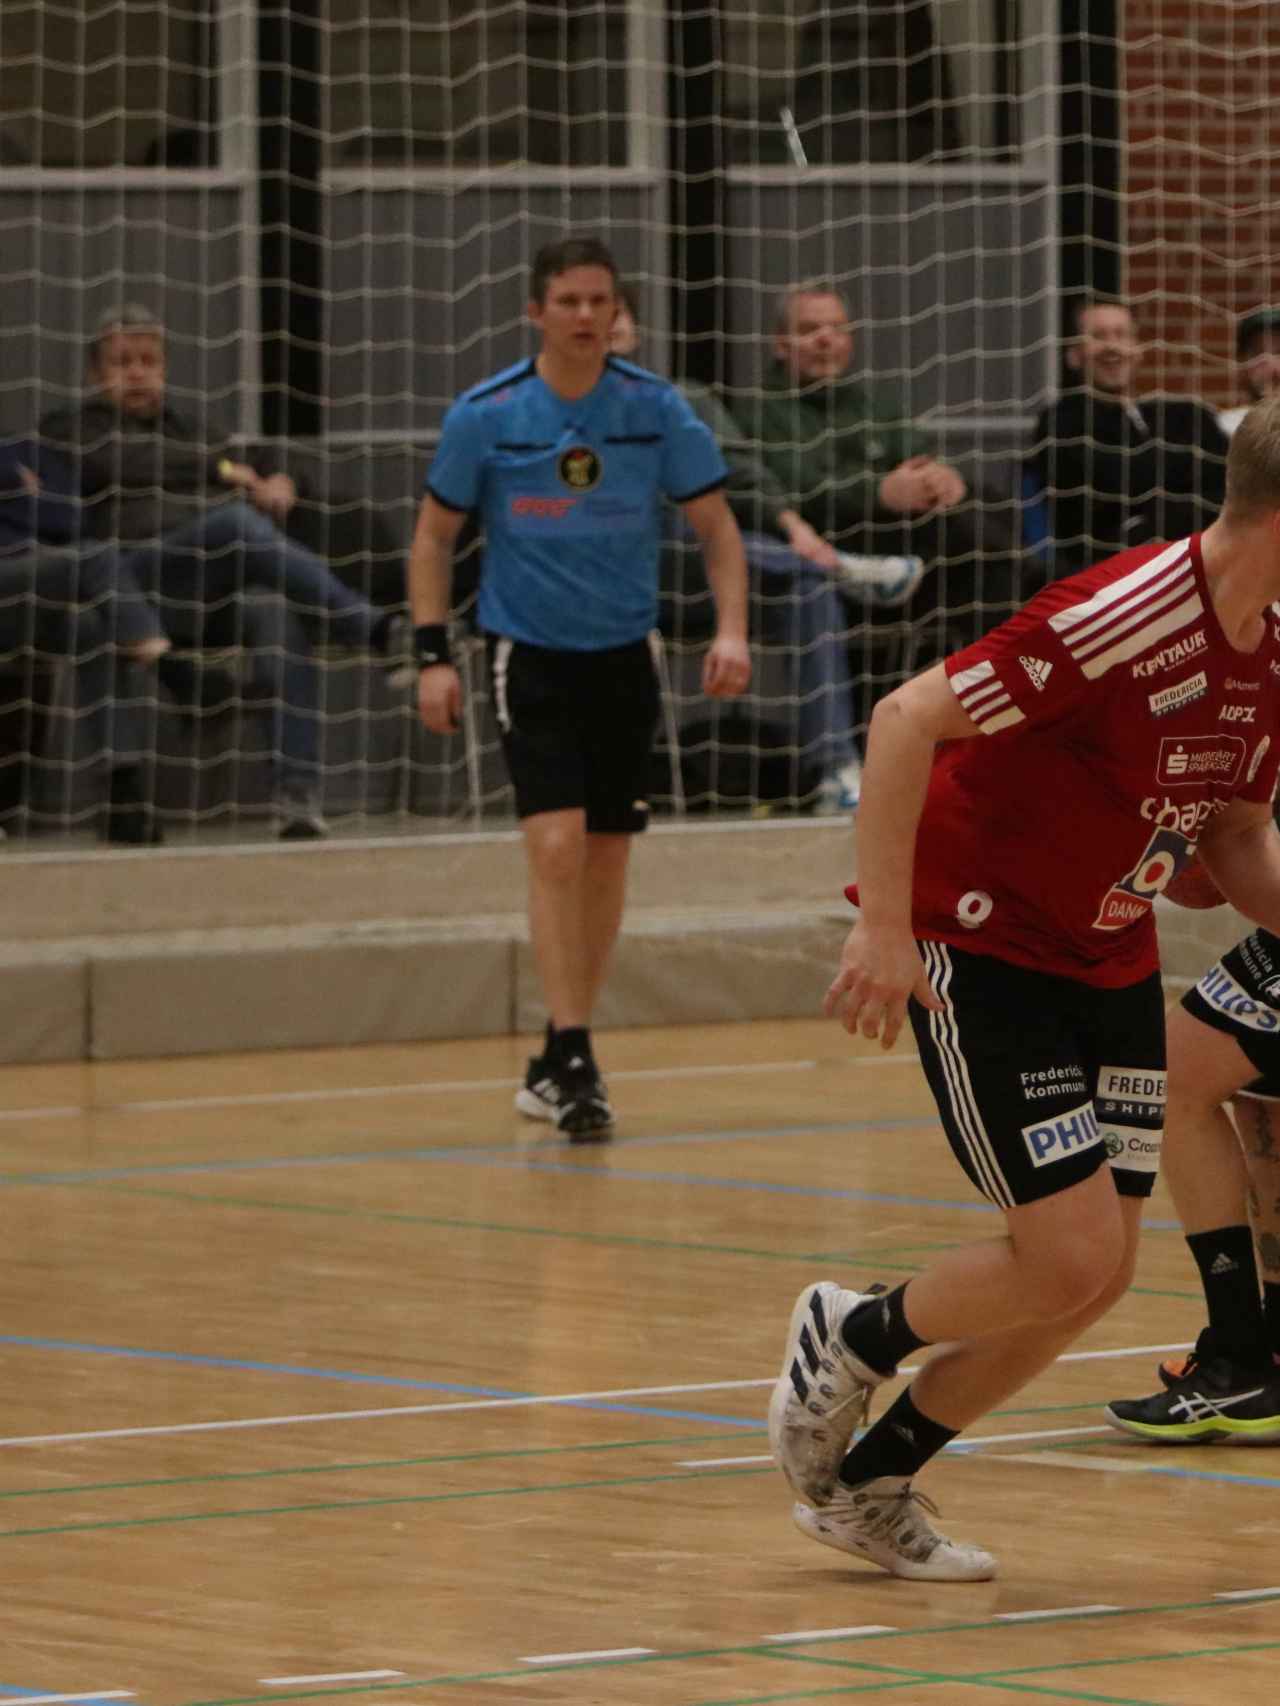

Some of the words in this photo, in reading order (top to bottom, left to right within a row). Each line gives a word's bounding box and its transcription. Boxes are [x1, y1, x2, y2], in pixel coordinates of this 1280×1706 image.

[1132, 629, 1208, 679] KENTAUR
[1108, 1073, 1166, 1098] FREDE
[1028, 1108, 1102, 1161] PHIL
